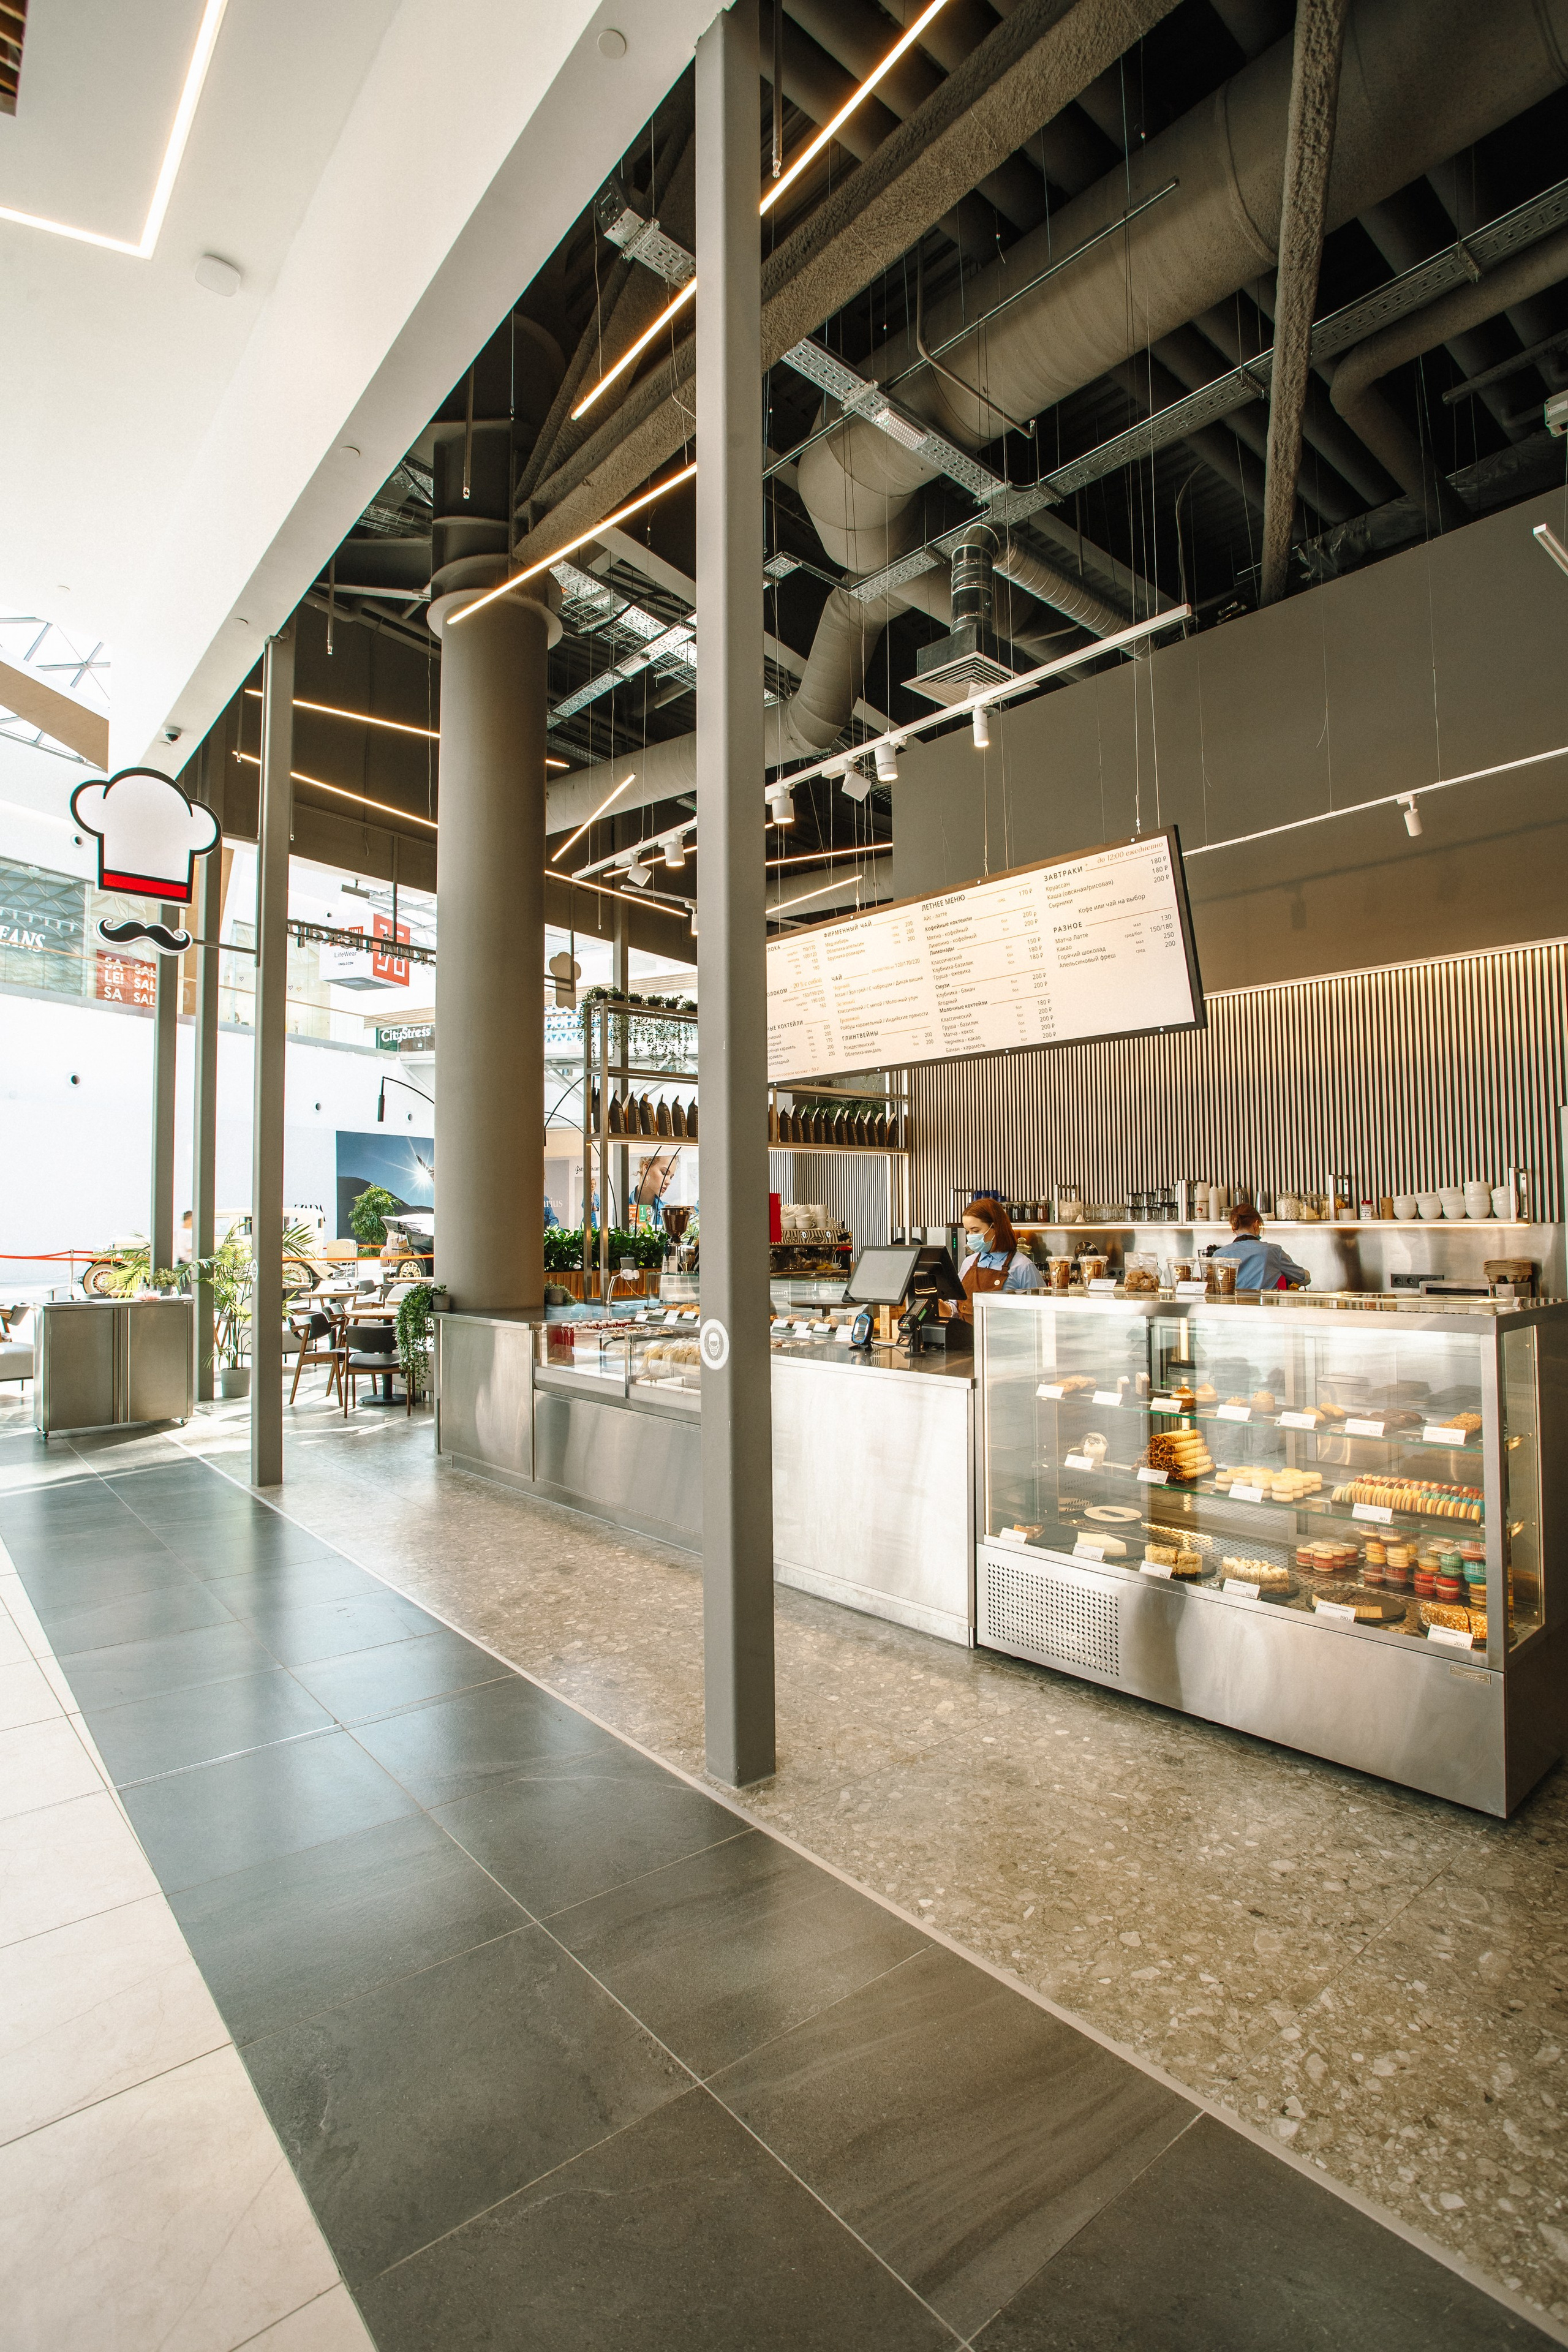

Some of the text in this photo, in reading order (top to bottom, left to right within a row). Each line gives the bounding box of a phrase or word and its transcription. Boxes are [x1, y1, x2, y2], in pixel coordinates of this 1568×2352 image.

[1108, 852, 1124, 861] 12:00
[1126, 842, 1163, 856] ежедневно
[1044, 866, 1083, 881] ЗАВТРАКИ
[1046, 883, 1070, 892] Круассан
[1063, 880, 1114, 897] (овсяная/рисовая)
[922, 894, 965, 911] ЛЕТНЕЕ МЕНЮ
[1126, 894, 1145, 902] выбор
[1049, 899, 1073, 909] Сырники
[824, 924, 858, 938] ФИРМЕННЫЙ
[925, 922, 949, 932] Кофейные
[1054, 922, 1082, 933] РАЗНОЕ
[1150, 923, 1173, 933] 150/180
[927, 927, 968, 941] Мятно кофейный
[929, 933, 977, 949] Лимонно кофейный
[930, 946, 954, 956] Лимонады
[1058, 951, 1080, 960] Горячий
[1082, 946, 1106, 956] шоколад
[895, 959, 920, 968] 120/170/220
[931, 955, 962, 965] Классический
[1060, 956, 1099, 968] Апельсиновый
[932, 960, 974, 973] Клубника-базилик
[105, 971, 124, 984] LE!
[951, 968, 971, 977] ежевика
[104, 986, 123, 1000] SA
[838, 1005, 863, 1014] Классический
[940, 1005, 964, 1013] Молочные
[941, 1013, 971, 1022] Классический
[778, 1020, 803, 1029] КОКТЕЙЛИ
[856, 1019, 882, 1028] карамельный
[842, 1031, 878, 1041] ГЛИНТВЕЙНЫ
[844, 1042, 875, 1050] Рождественский
